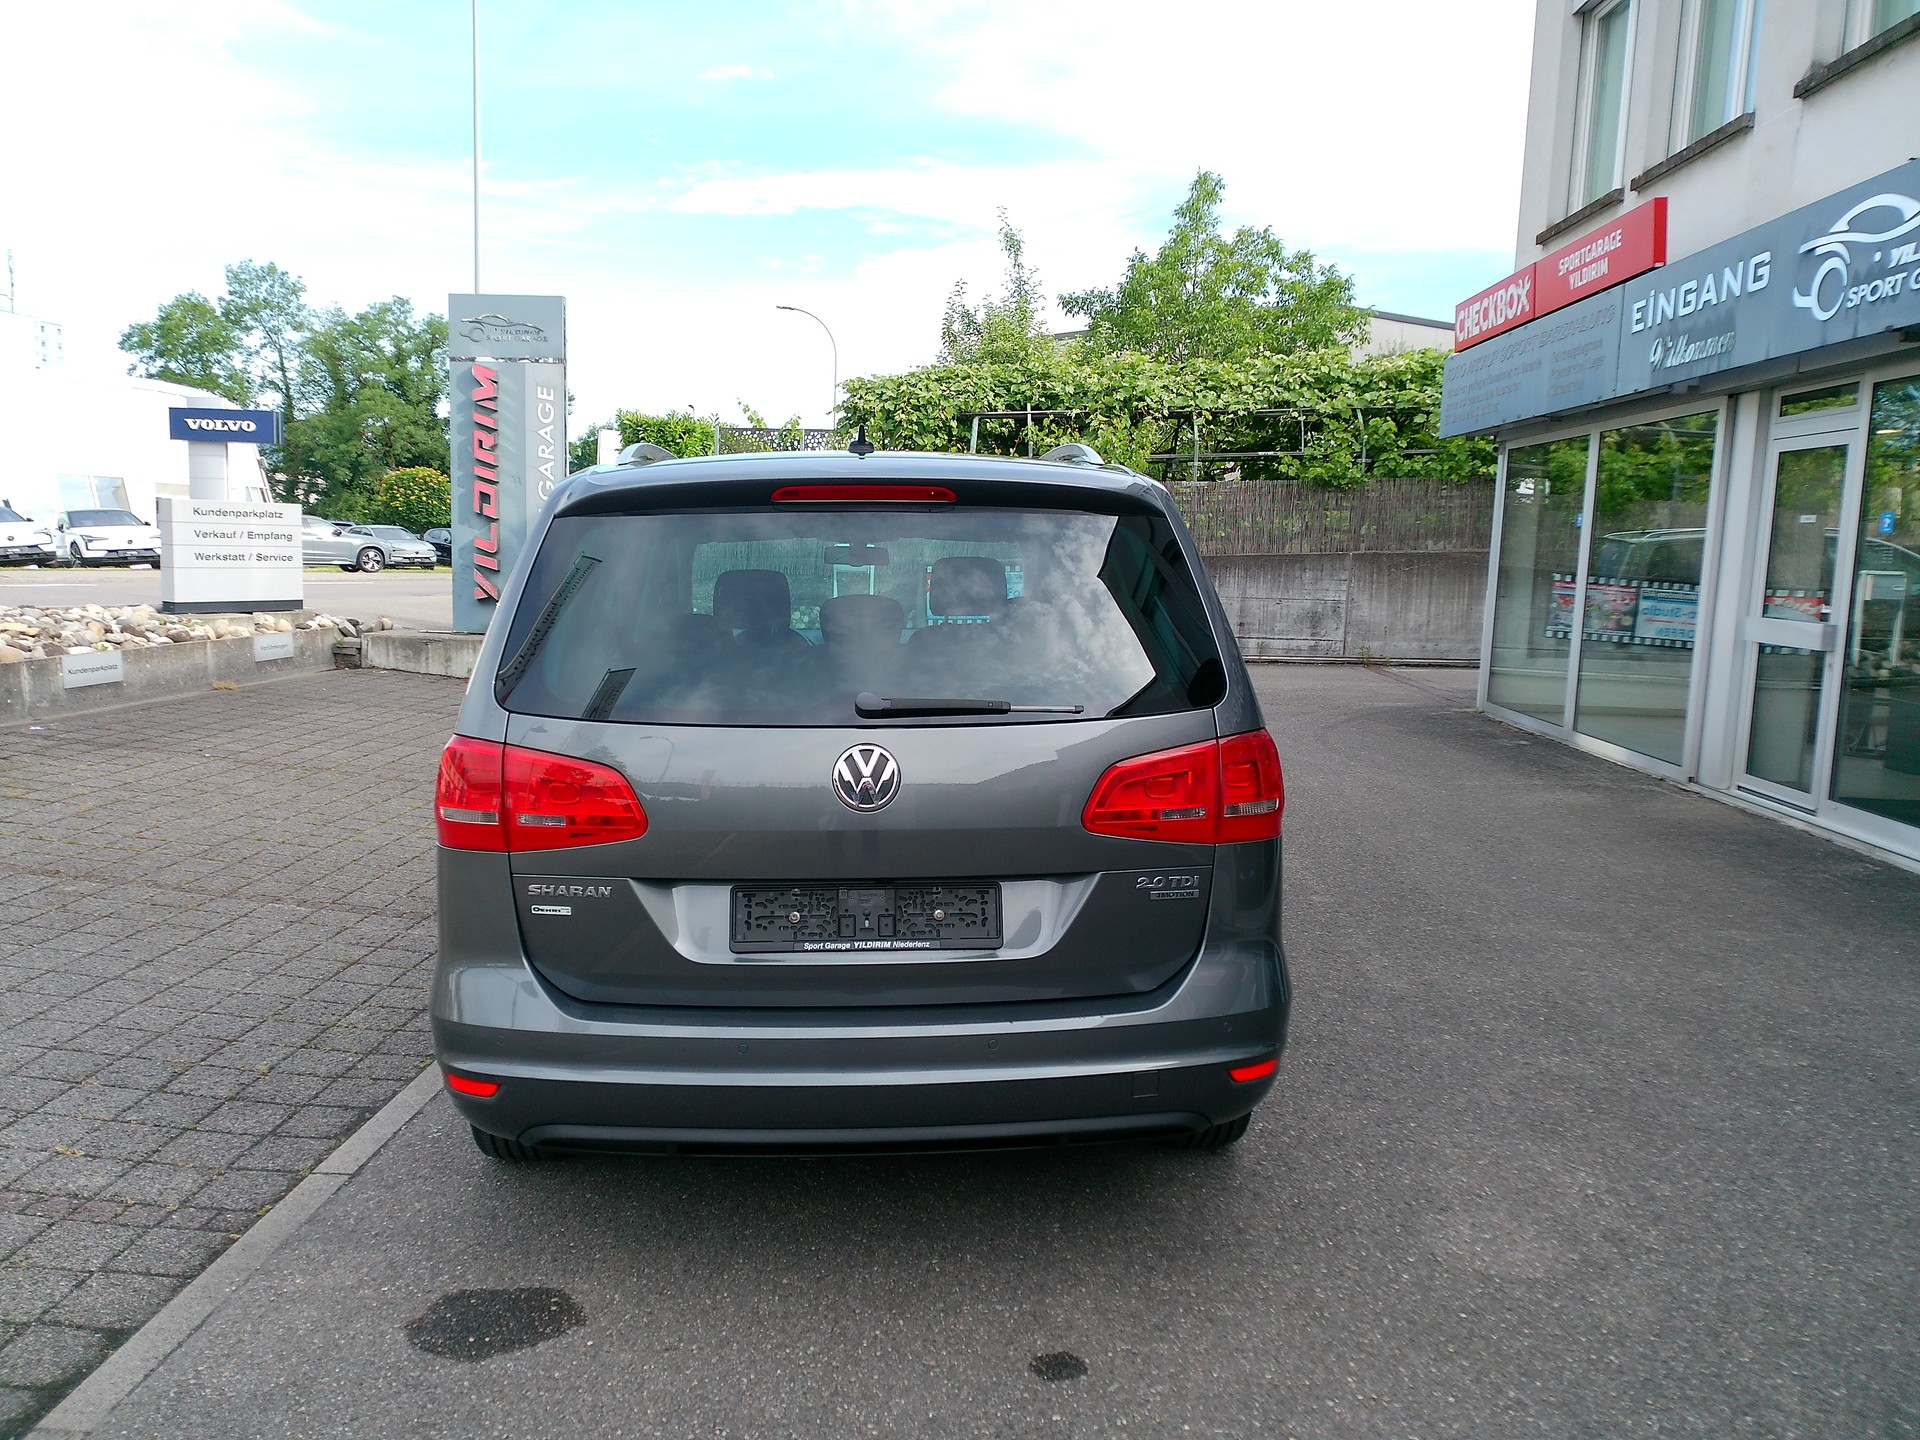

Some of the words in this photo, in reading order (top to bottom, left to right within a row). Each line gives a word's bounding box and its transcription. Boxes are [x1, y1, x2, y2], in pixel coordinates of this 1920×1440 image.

[1558, 228, 1622, 276] SPORTGARAGE
[1568, 257, 1608, 290] YILDIRIM
[1846, 271, 1909, 309] SPORT
[1455, 274, 1532, 343] CHECKBOX
[184, 418, 257, 432] VOLVO
[537, 385, 555, 501] GARAGE
[472, 363, 499, 603] YILDIRIM
[192, 507, 284, 519] Kundenparkplatz
[194, 529, 237, 539] Verkauf
[247, 530, 293, 542] Empfang
[194, 552, 246, 561] Werkstatt
[255, 553, 294, 562] Service
[67, 663, 119, 676] Kundenparkplatz
[1136, 876, 1166, 889] 2.0
[1168, 875, 1200, 888] TDI
[527, 883, 613, 898] SHARAN
[803, 942, 823, 950] Sport
[824, 942, 851, 950] Garage
[853, 941, 891, 949] YILDIRIM
[892, 940, 931, 949] Niederlenz
